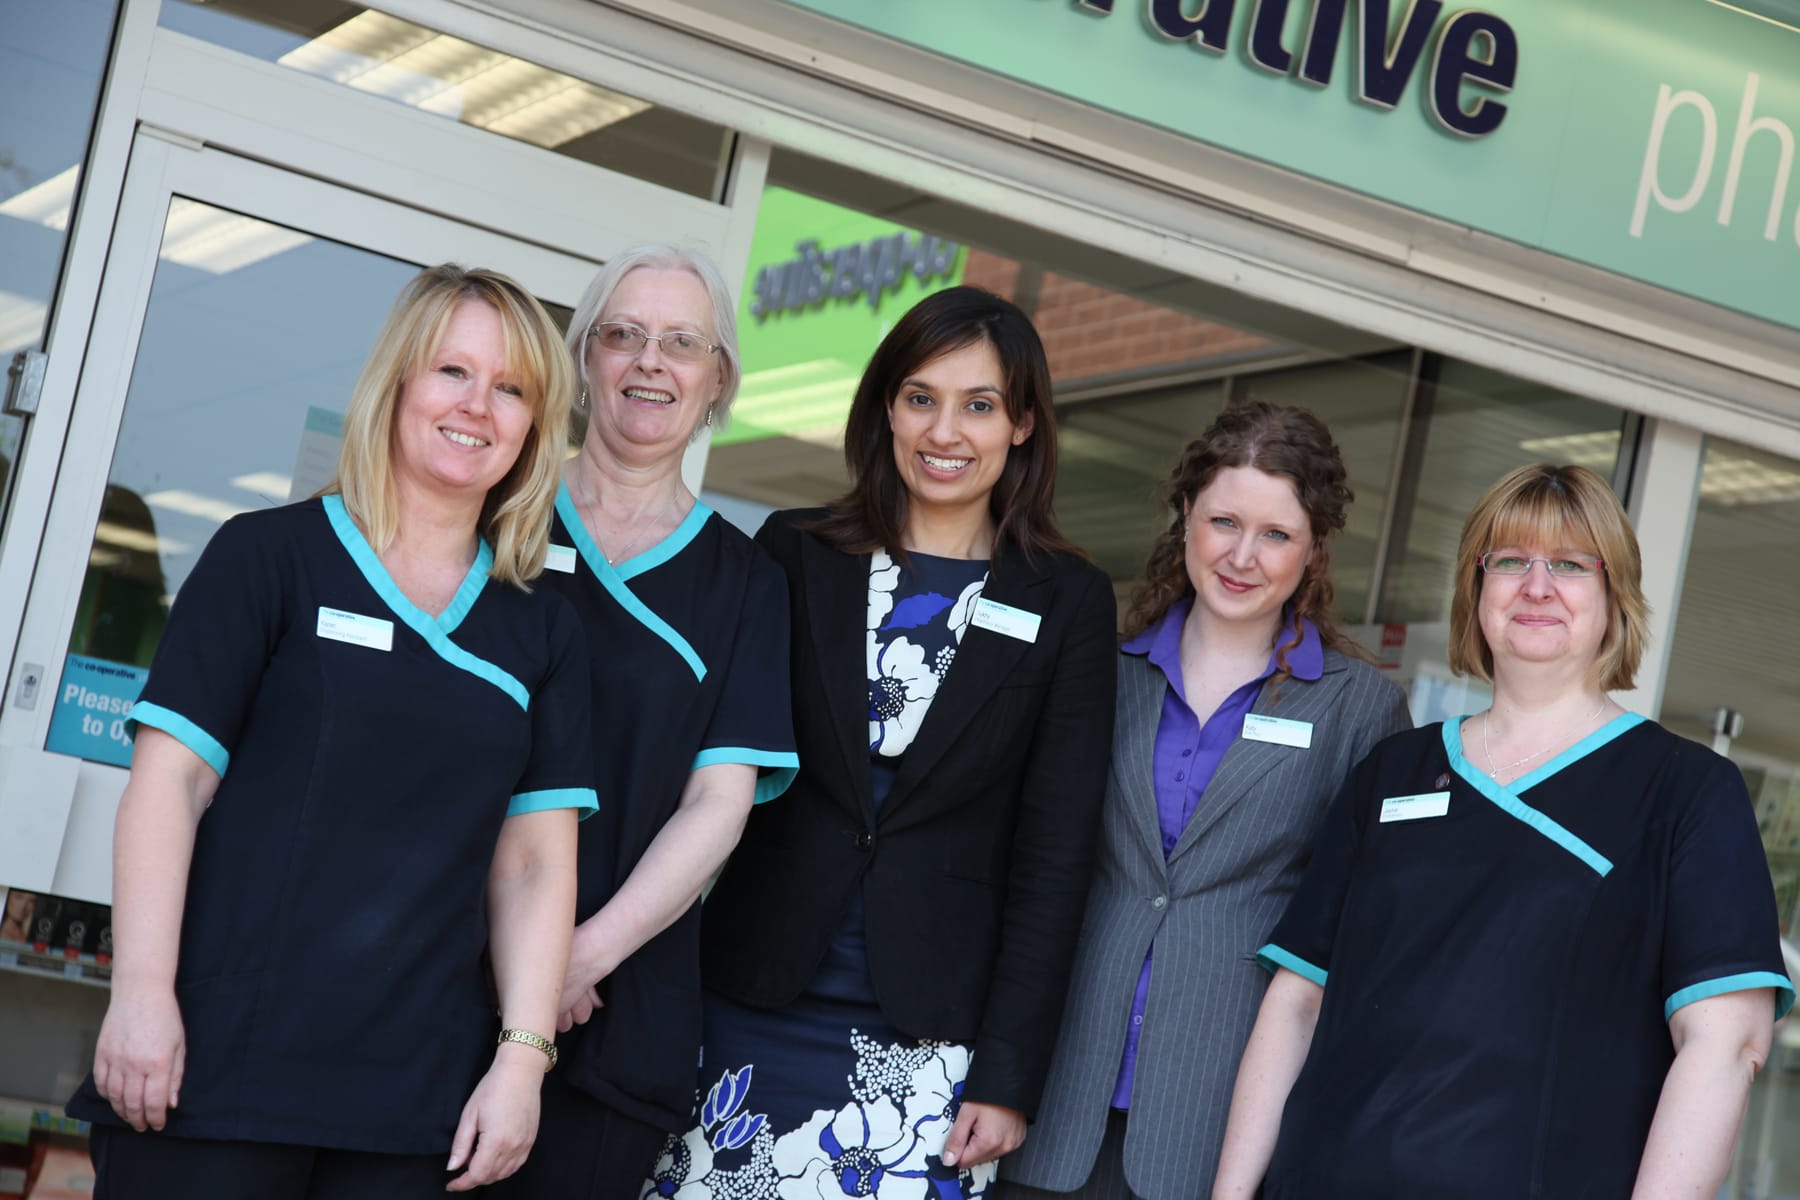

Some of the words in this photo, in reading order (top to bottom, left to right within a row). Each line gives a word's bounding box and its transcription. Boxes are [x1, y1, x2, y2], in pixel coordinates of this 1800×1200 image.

[1068, 0, 1519, 138] ative
[1628, 71, 1800, 249] ph
[64, 684, 134, 716] Please
[82, 714, 103, 736] to
